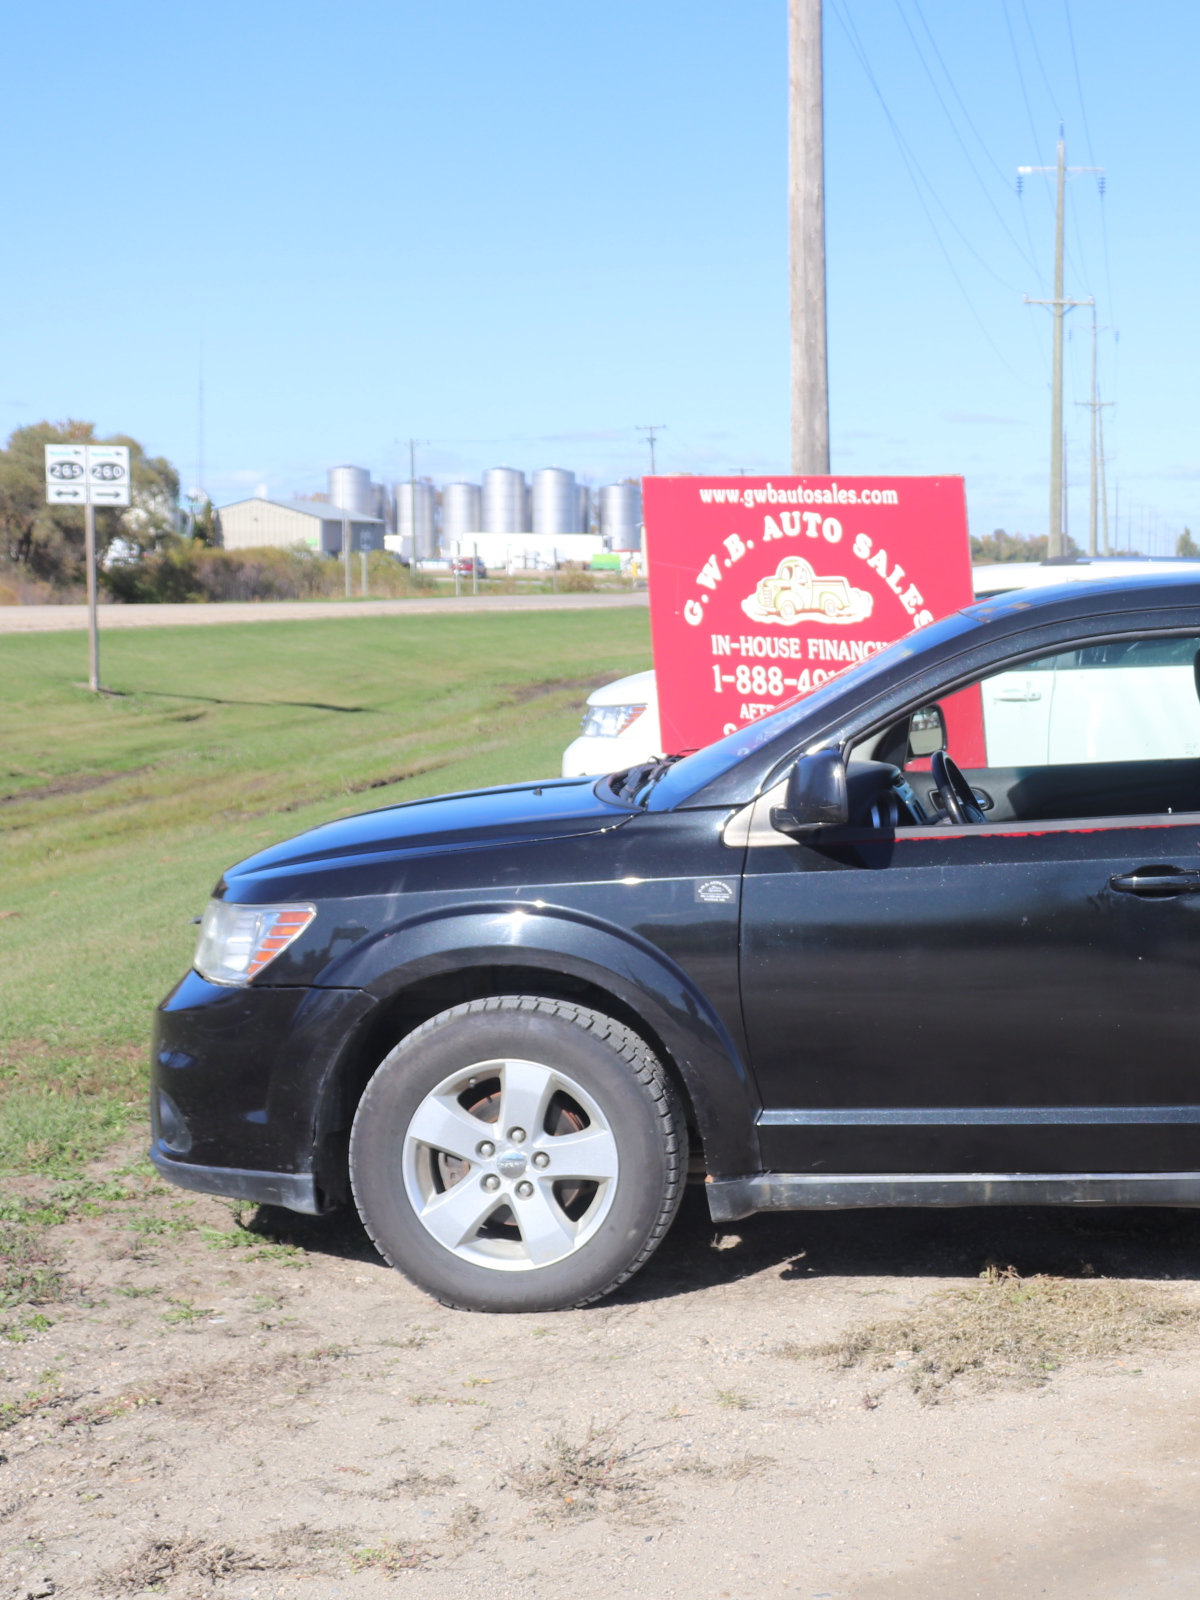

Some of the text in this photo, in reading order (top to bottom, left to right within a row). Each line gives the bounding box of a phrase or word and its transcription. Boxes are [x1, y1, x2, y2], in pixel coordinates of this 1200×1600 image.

[52, 464, 80, 477] 265
[93, 465, 122, 479] 260
[699, 482, 899, 508] www.gwbautosales.com
[763, 511, 842, 543] AUTO
[853, 533, 934, 629] SALES
[711, 634, 889, 662] IN-HOUSE FINANC
